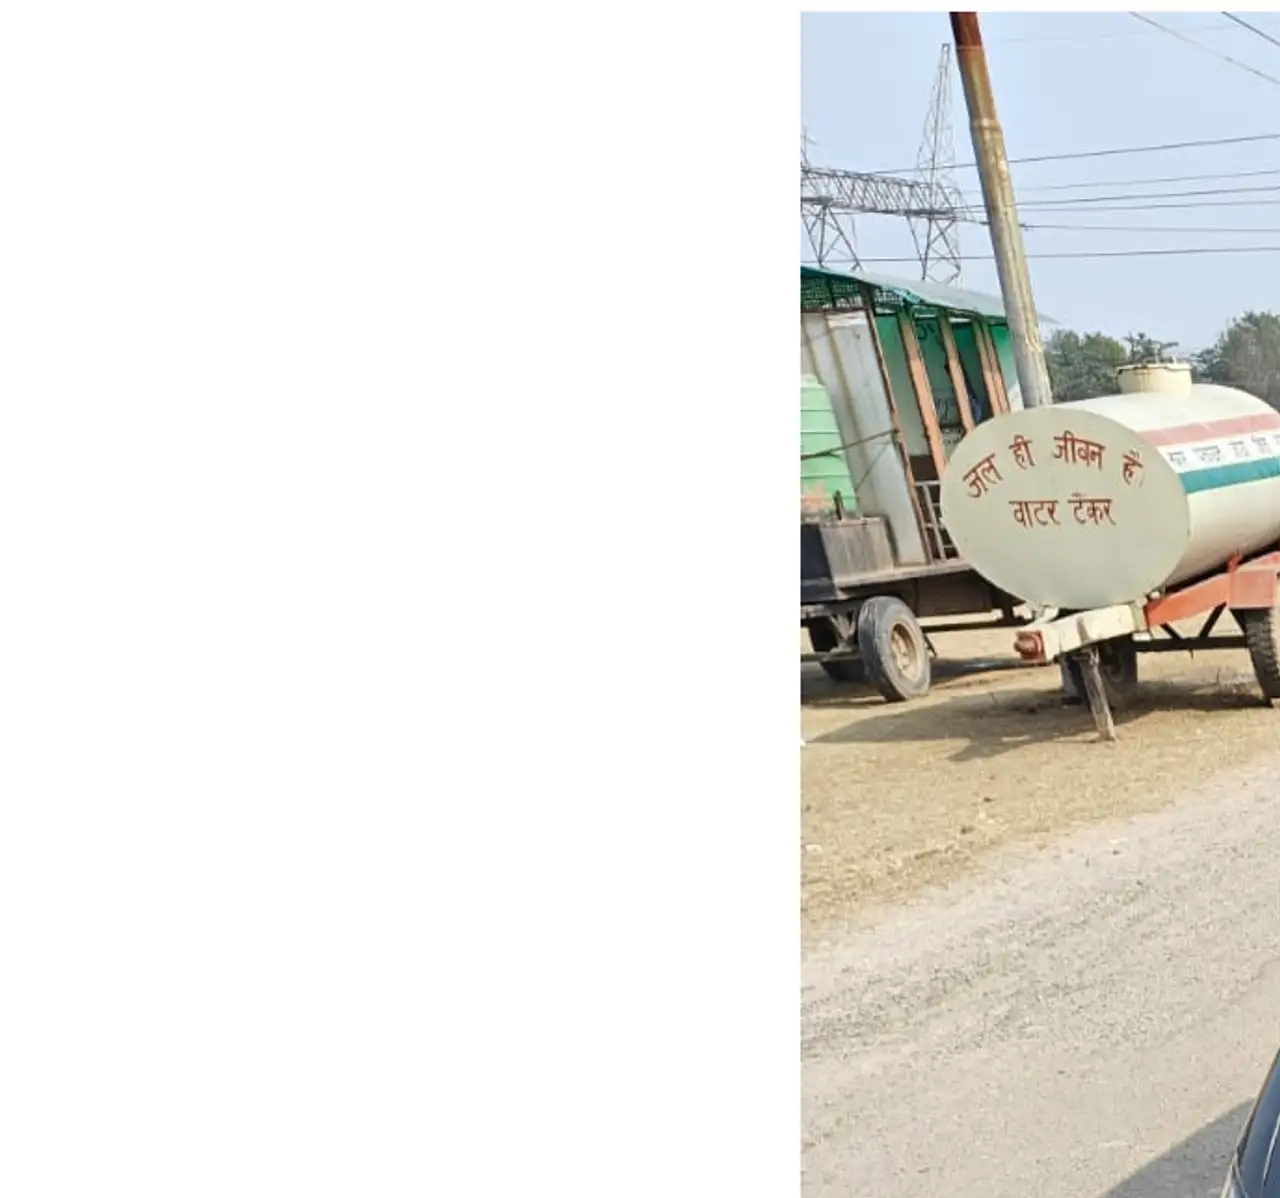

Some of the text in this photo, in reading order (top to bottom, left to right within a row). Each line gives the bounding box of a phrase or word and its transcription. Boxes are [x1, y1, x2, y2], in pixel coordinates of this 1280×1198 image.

[962, 453, 1003, 498] जल
[1009, 434, 1035, 469] ही
[1053, 430, 1105, 469] जीवन
[1009, 500, 1061, 528] वाटर
